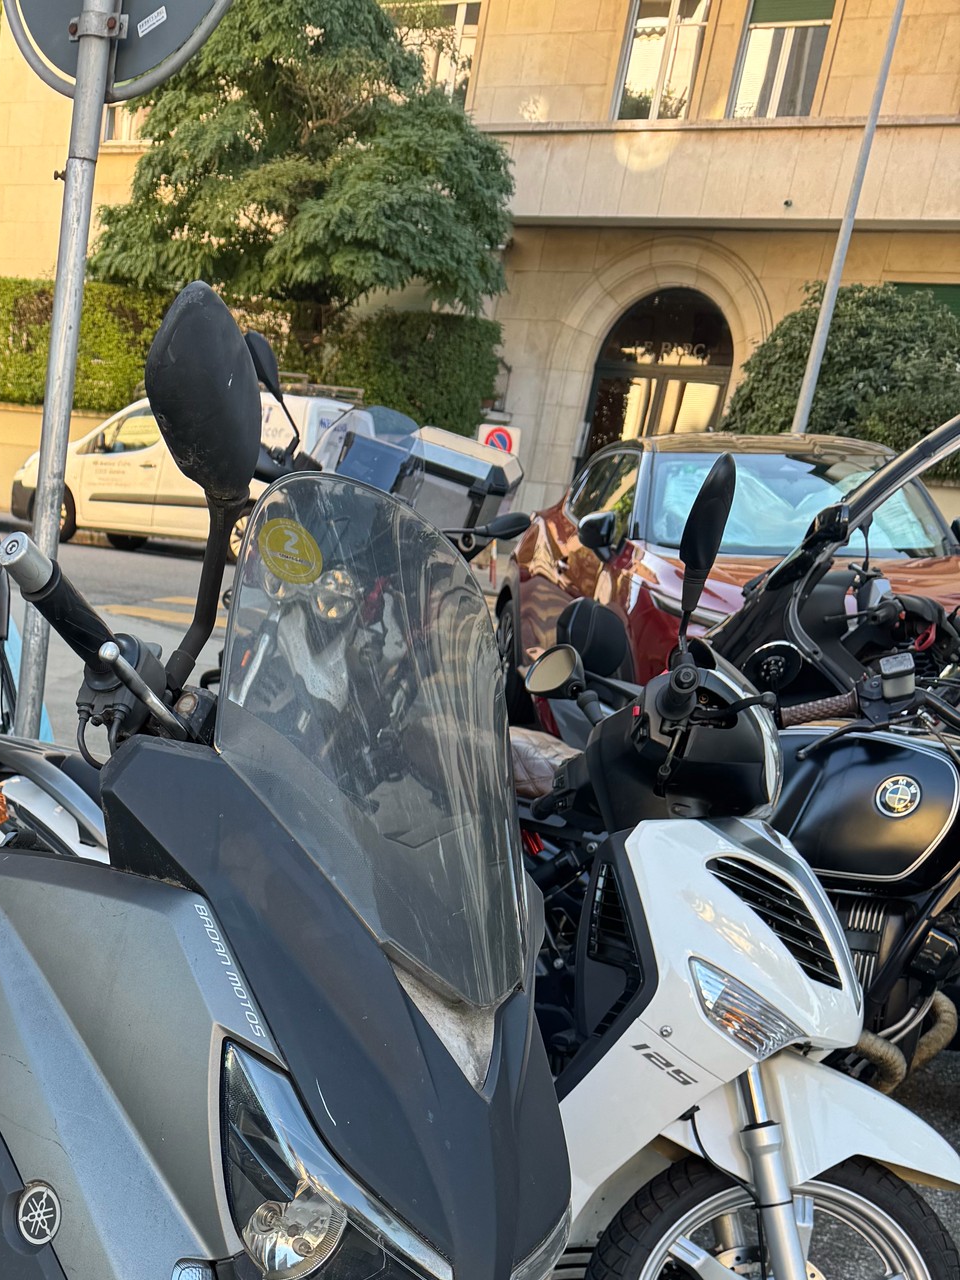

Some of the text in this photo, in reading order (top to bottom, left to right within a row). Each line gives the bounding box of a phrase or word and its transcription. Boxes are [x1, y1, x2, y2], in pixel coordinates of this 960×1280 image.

[284, 529, 299, 555] 2
[194, 903, 266, 1038] BADAN MOTOS
[631, 1043, 699, 1086] 125
